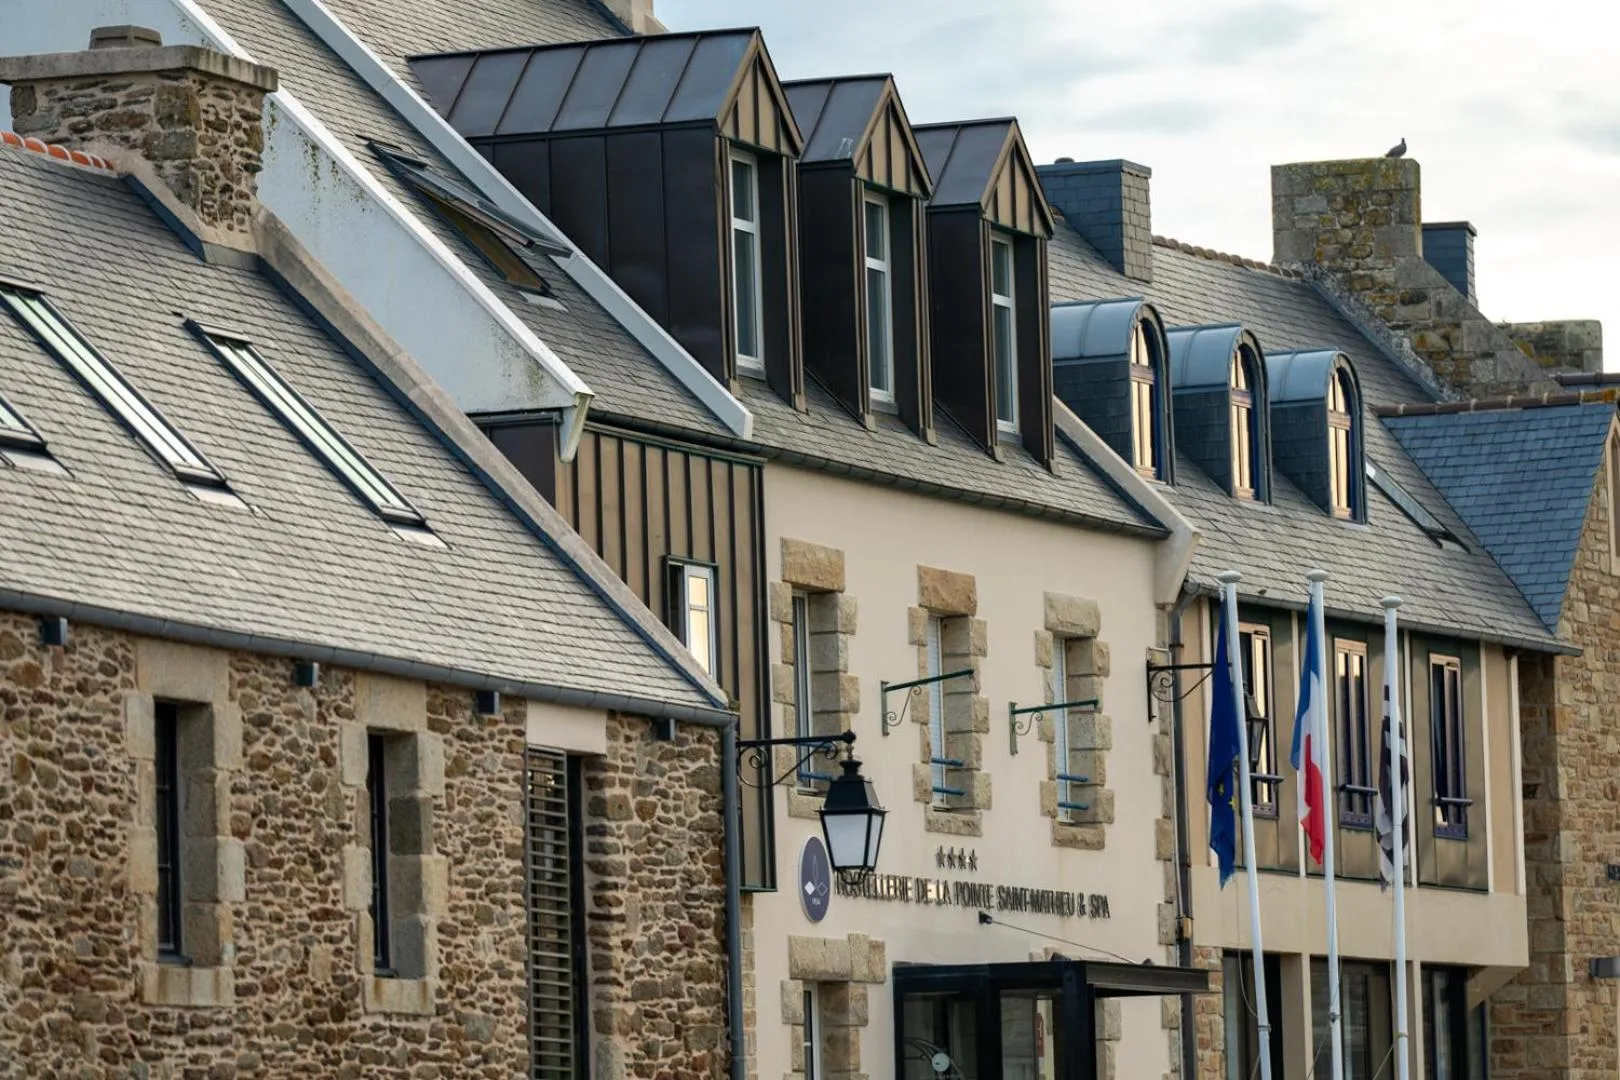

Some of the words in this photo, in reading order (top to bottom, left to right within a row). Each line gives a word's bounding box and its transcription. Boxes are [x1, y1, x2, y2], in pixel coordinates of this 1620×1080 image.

[915, 877, 933, 905] DE
[935, 880, 952, 906] LA
[953, 881, 994, 910] POINTE
[1077, 892, 1087, 918] &
[1088, 893, 1111, 920] SPA
